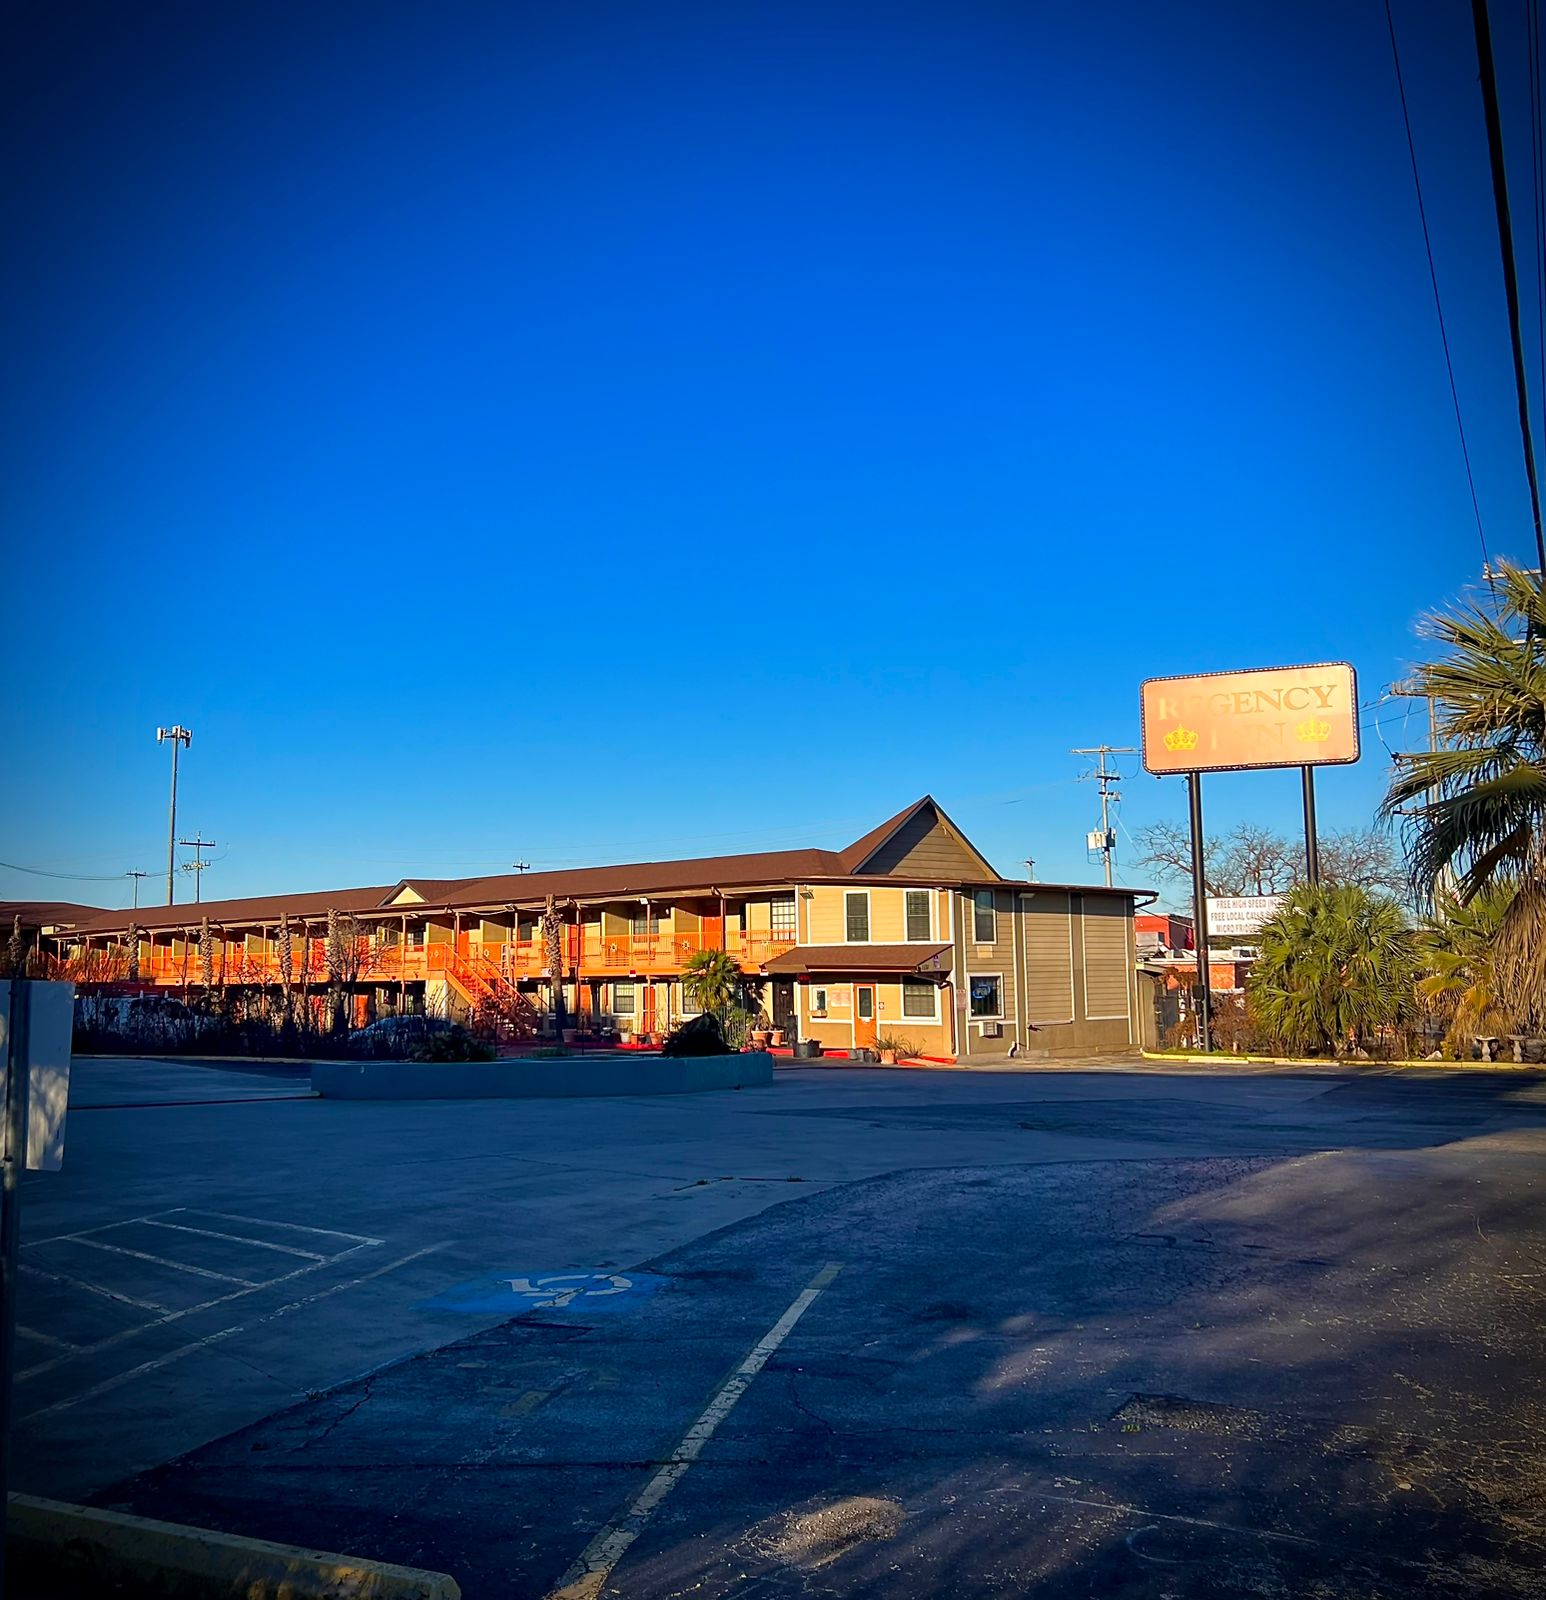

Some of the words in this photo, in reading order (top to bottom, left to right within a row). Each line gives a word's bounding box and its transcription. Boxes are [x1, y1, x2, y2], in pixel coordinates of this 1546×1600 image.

[1210, 721, 1287, 750] IN
[1216, 900, 1231, 909] FREE
[1231, 900, 1247, 909] HIGH
[1248, 899, 1266, 908] SPEED
[1211, 912, 1225, 921] FREE
[1226, 912, 1245, 921] LOCAL
[1216, 924, 1234, 933] MICRO
